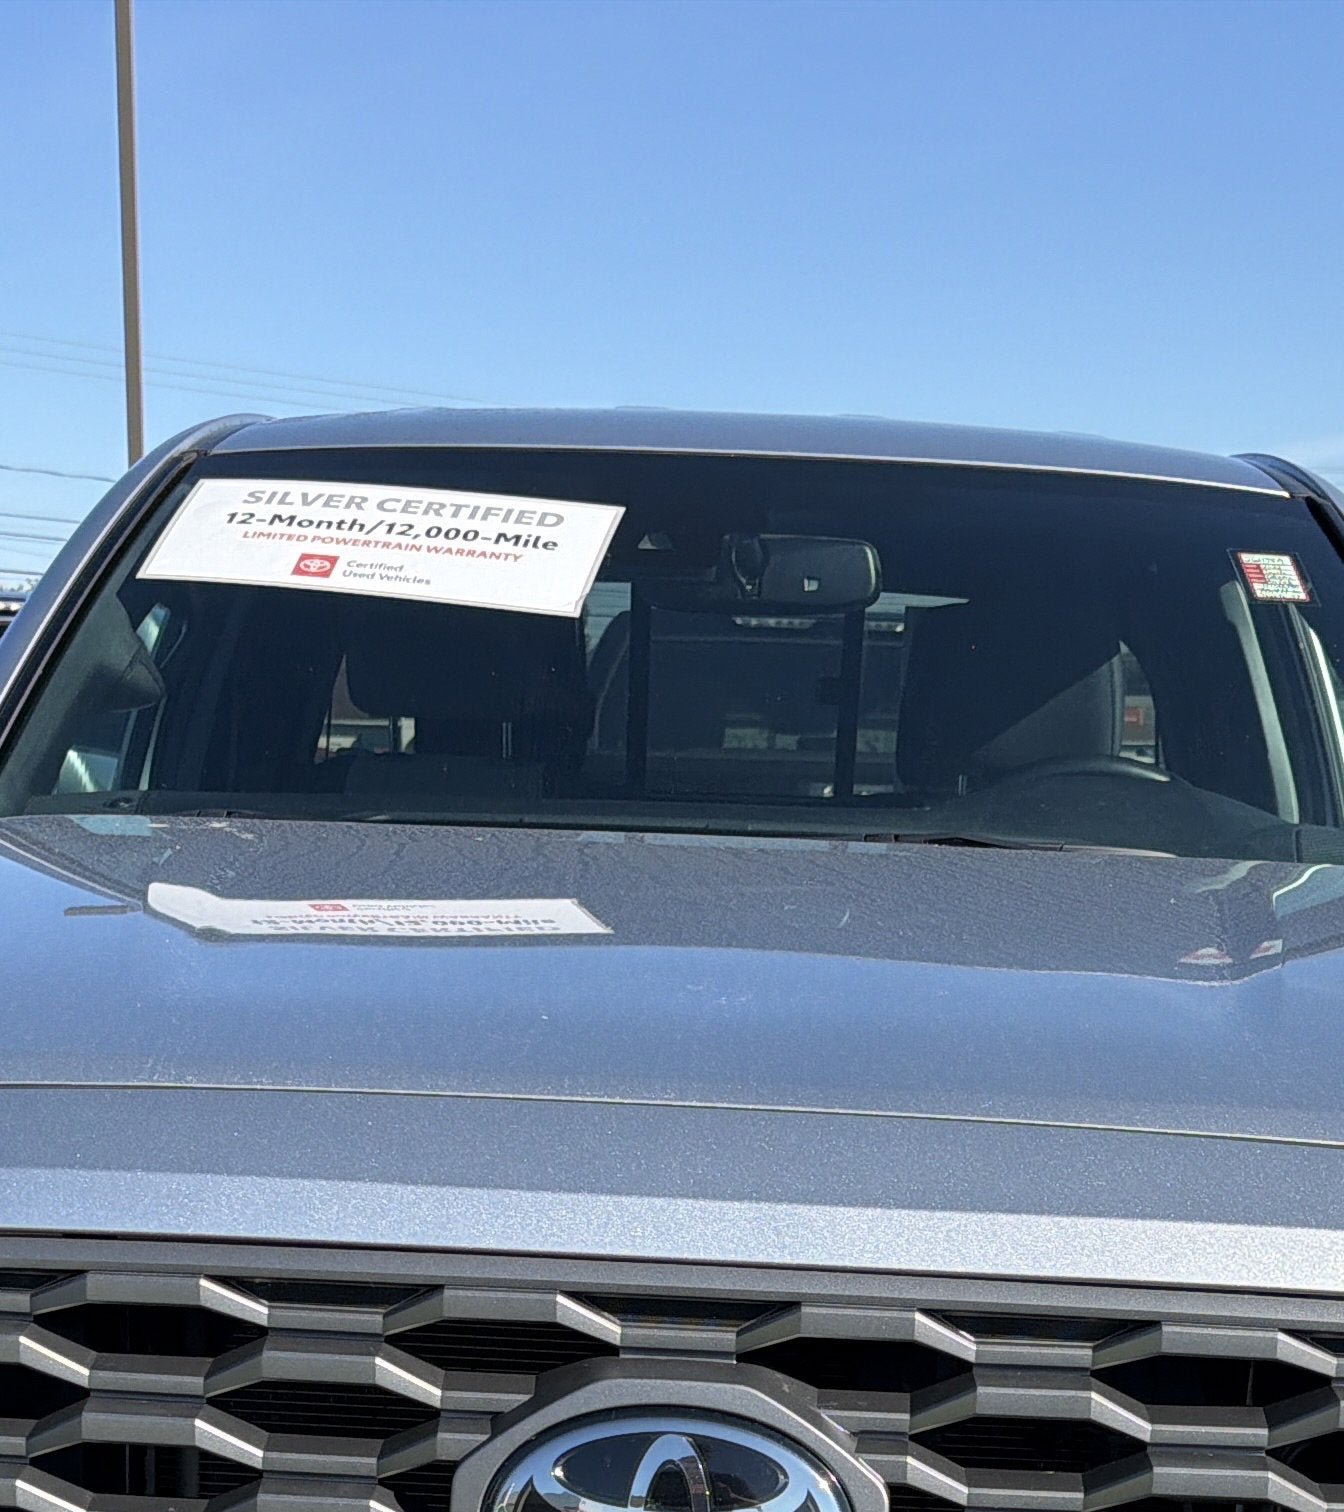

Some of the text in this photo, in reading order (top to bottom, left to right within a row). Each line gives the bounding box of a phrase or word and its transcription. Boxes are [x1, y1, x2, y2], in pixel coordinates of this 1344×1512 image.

[242, 490, 565, 528] SILVER CERTIFIED
[226, 511, 559, 551] 12-Month/12,000-Mile
[242, 530, 524, 563] LIMITED POWERTRAIN WARRANTY
[342, 569, 432, 586] Used Vehicles
[346, 559, 405, 573] Certified
